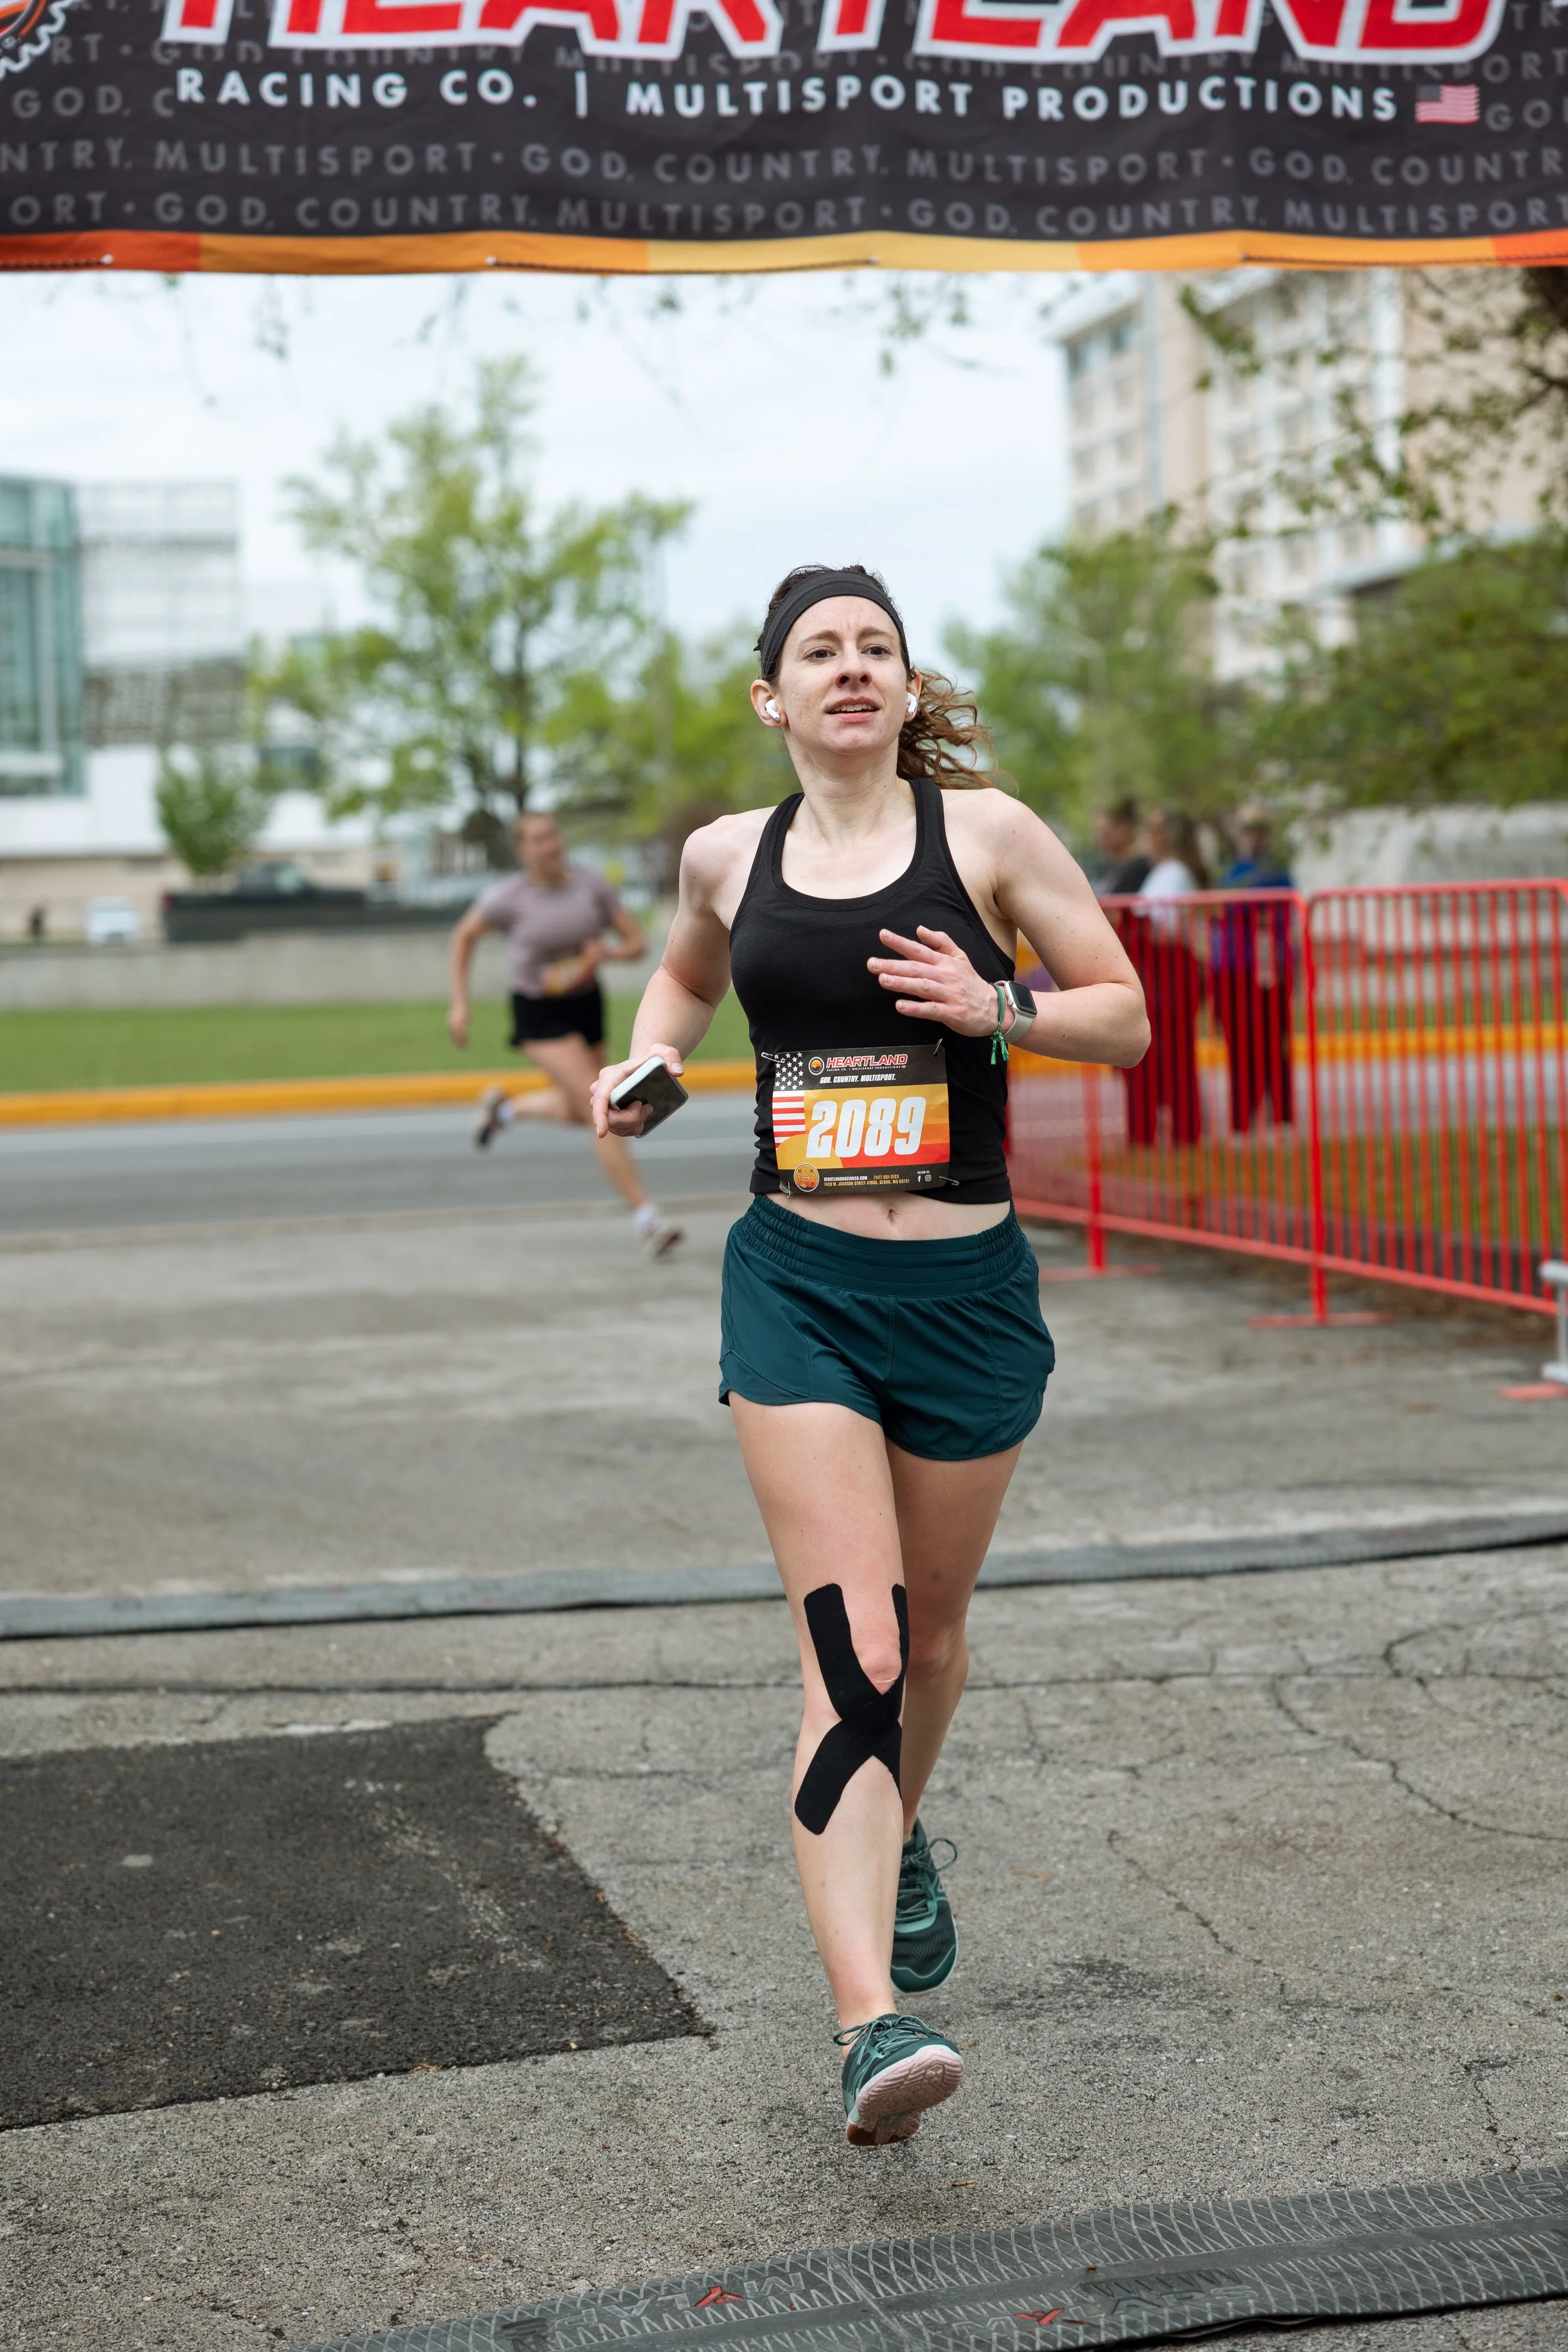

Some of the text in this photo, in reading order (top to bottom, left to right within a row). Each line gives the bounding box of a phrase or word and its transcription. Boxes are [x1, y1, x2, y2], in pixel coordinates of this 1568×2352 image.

[176, 67, 408, 109] RACING
[440, 69, 537, 108] CO.
[626, 74, 973, 117] MULTISPORT
[1003, 76, 1397, 122] PRODUCTIONS
[154, 140, 476, 176] MULTISPORT
[907, 147, 1208, 186] MULTISPORT
[557, 197, 866, 232] MULTISPORT
[1284, 194, 1568, 232] MULTISPORT
[826, 1054, 908, 1068] HEARTLAND
[833, 1075, 859, 1083] COUNTRY.
[860, 1074, 896, 1082] MULTISPORT.
[806, 1096, 926, 1158] 2089
